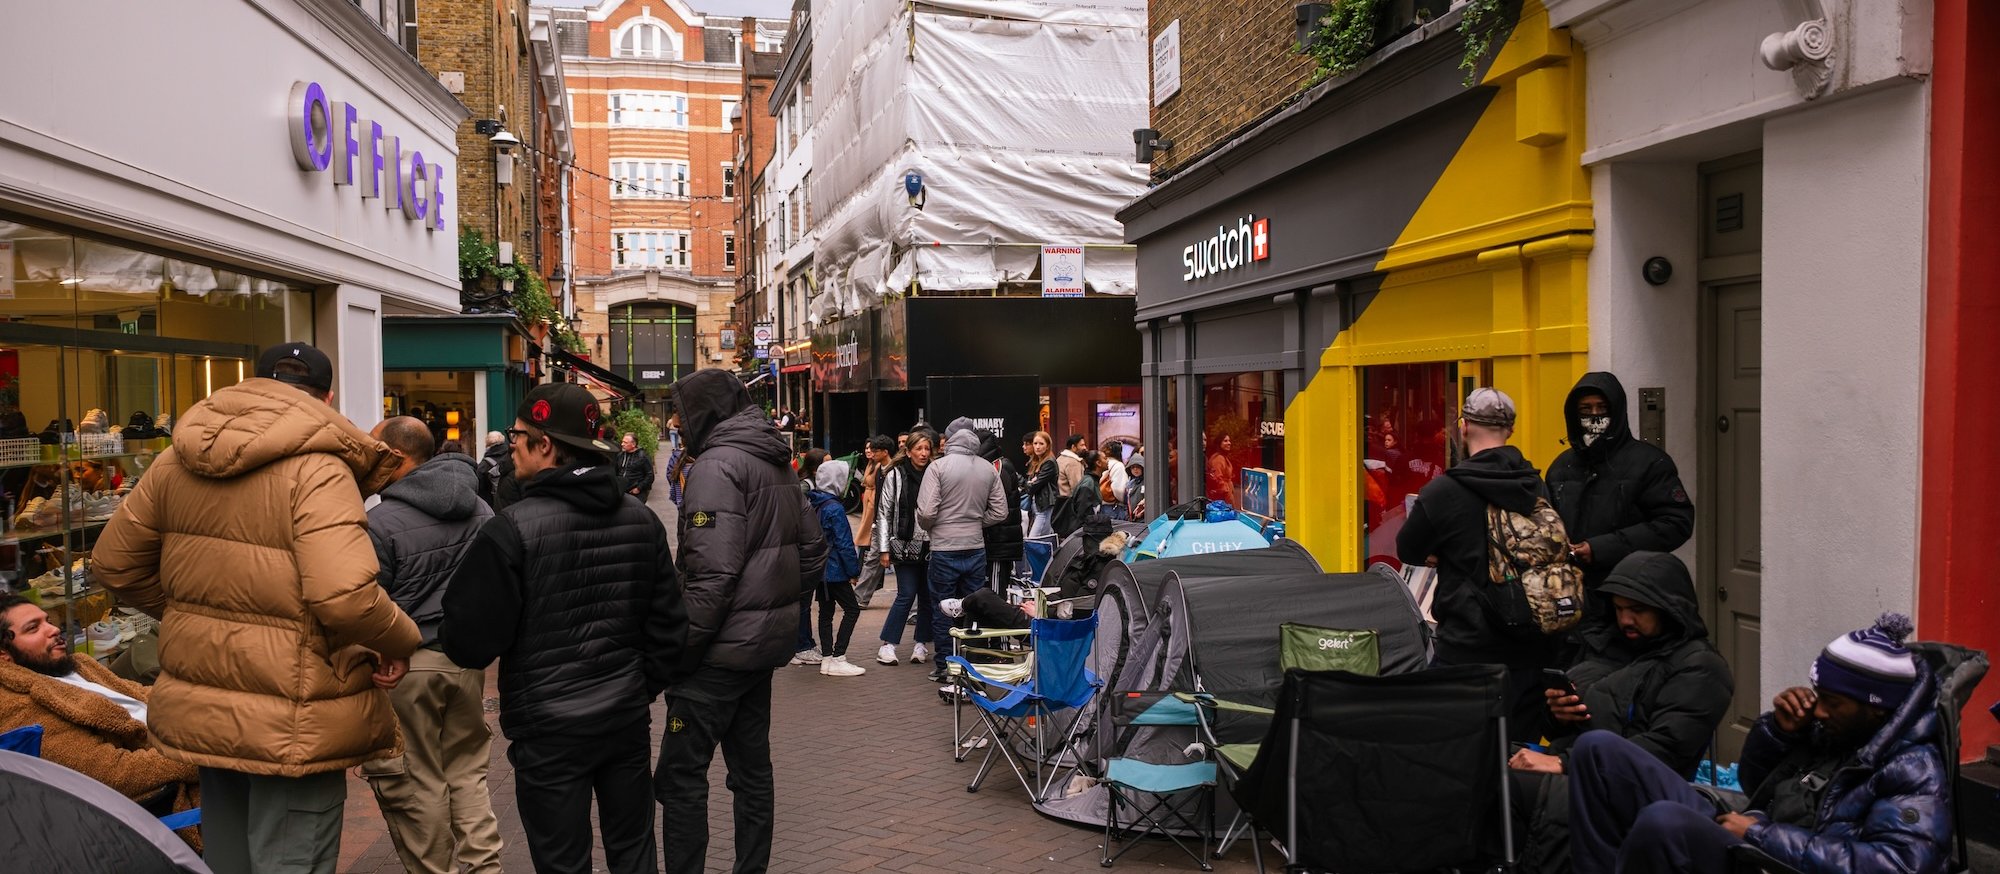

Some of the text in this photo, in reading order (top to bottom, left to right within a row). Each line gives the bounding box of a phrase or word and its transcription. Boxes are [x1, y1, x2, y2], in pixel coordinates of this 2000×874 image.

[288, 80, 445, 231] OFFICE
[1183, 213, 1254, 281] swatch
[970, 418, 1005, 431] ARNABY
[1260, 421, 1285, 437] SCUB
[1318, 637, 1349, 650] gelert
